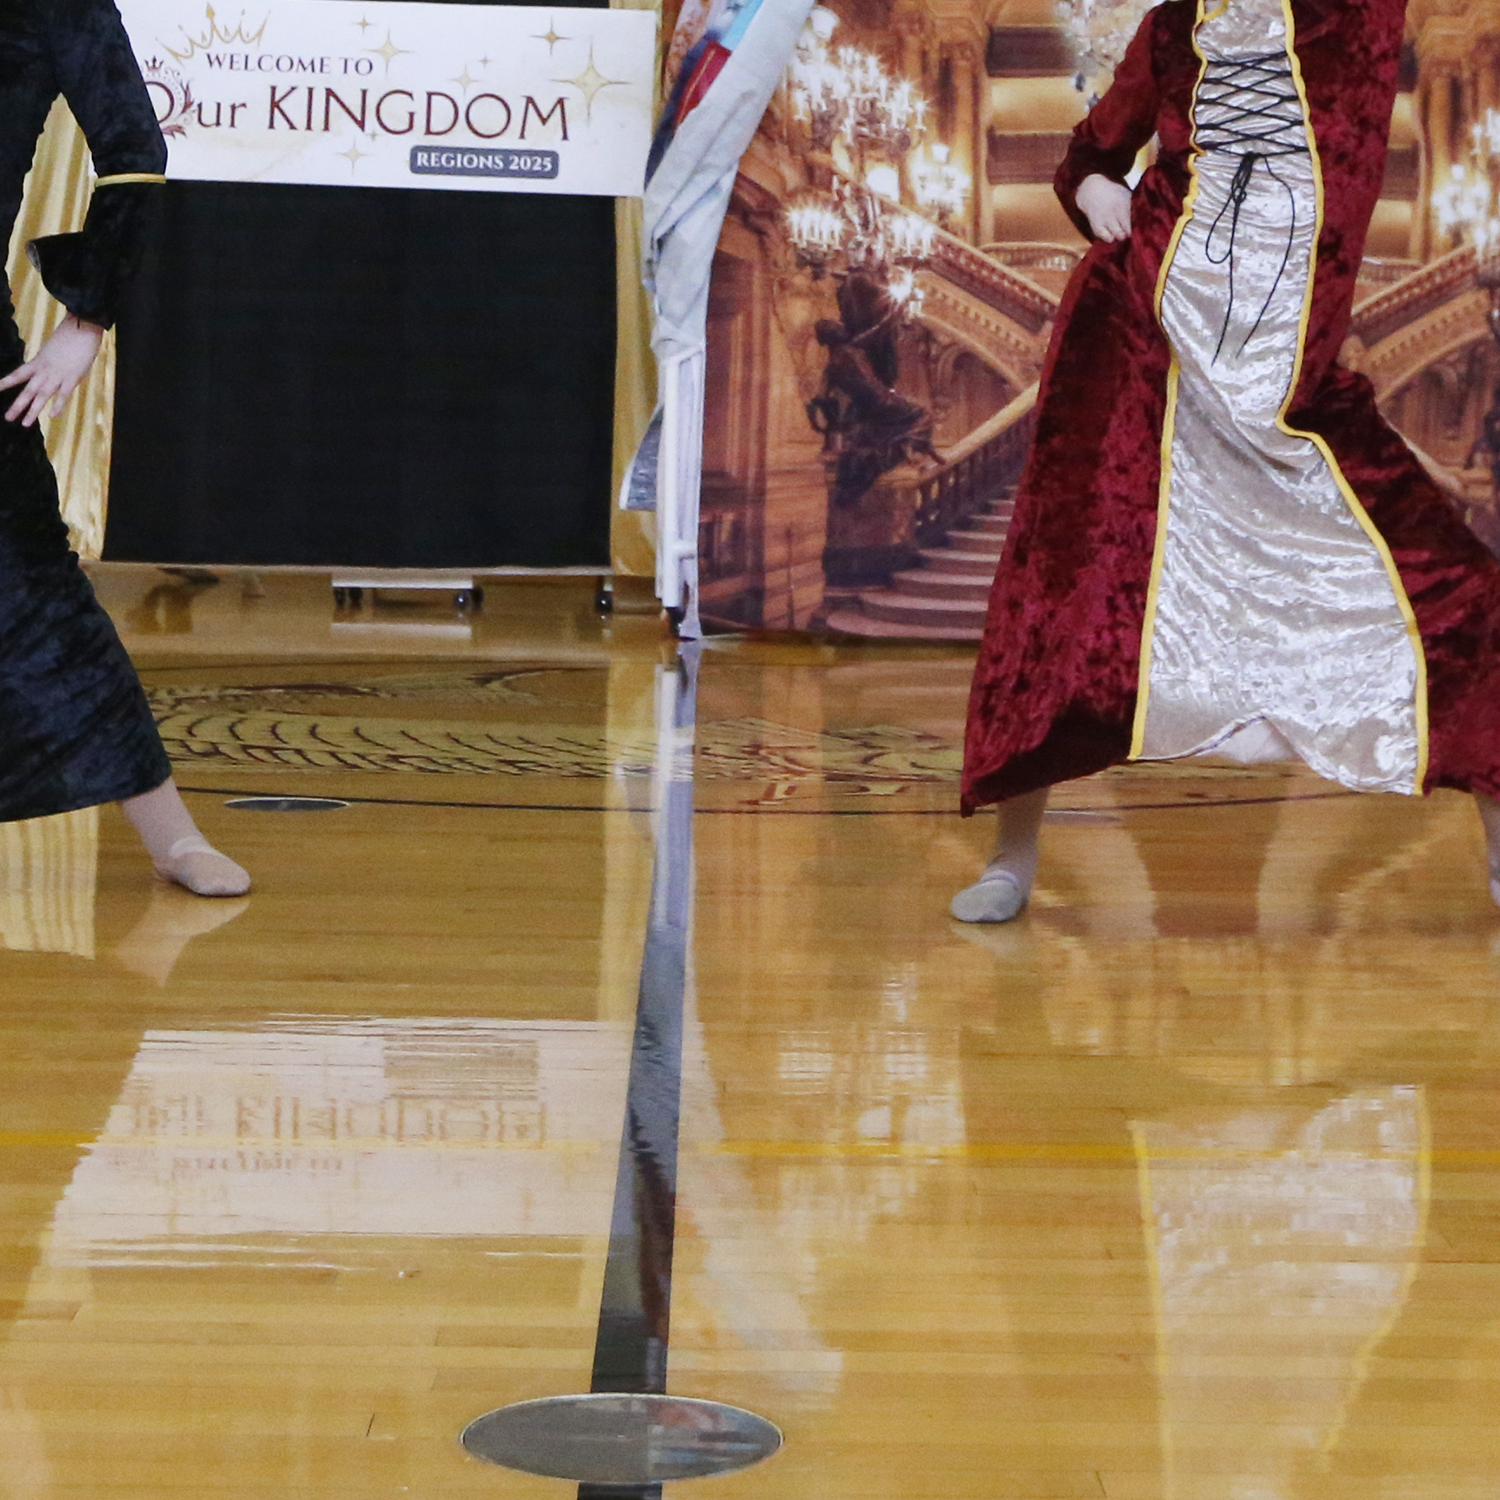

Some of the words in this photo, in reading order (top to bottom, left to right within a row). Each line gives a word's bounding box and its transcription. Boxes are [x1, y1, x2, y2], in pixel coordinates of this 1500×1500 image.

[206, 52, 331, 75] WELCOME
[339, 56, 374, 76] TO
[267, 84, 571, 142] KINGDOM
[416, 150, 503, 171] REGIONS
[509, 154, 553, 173] 2025
